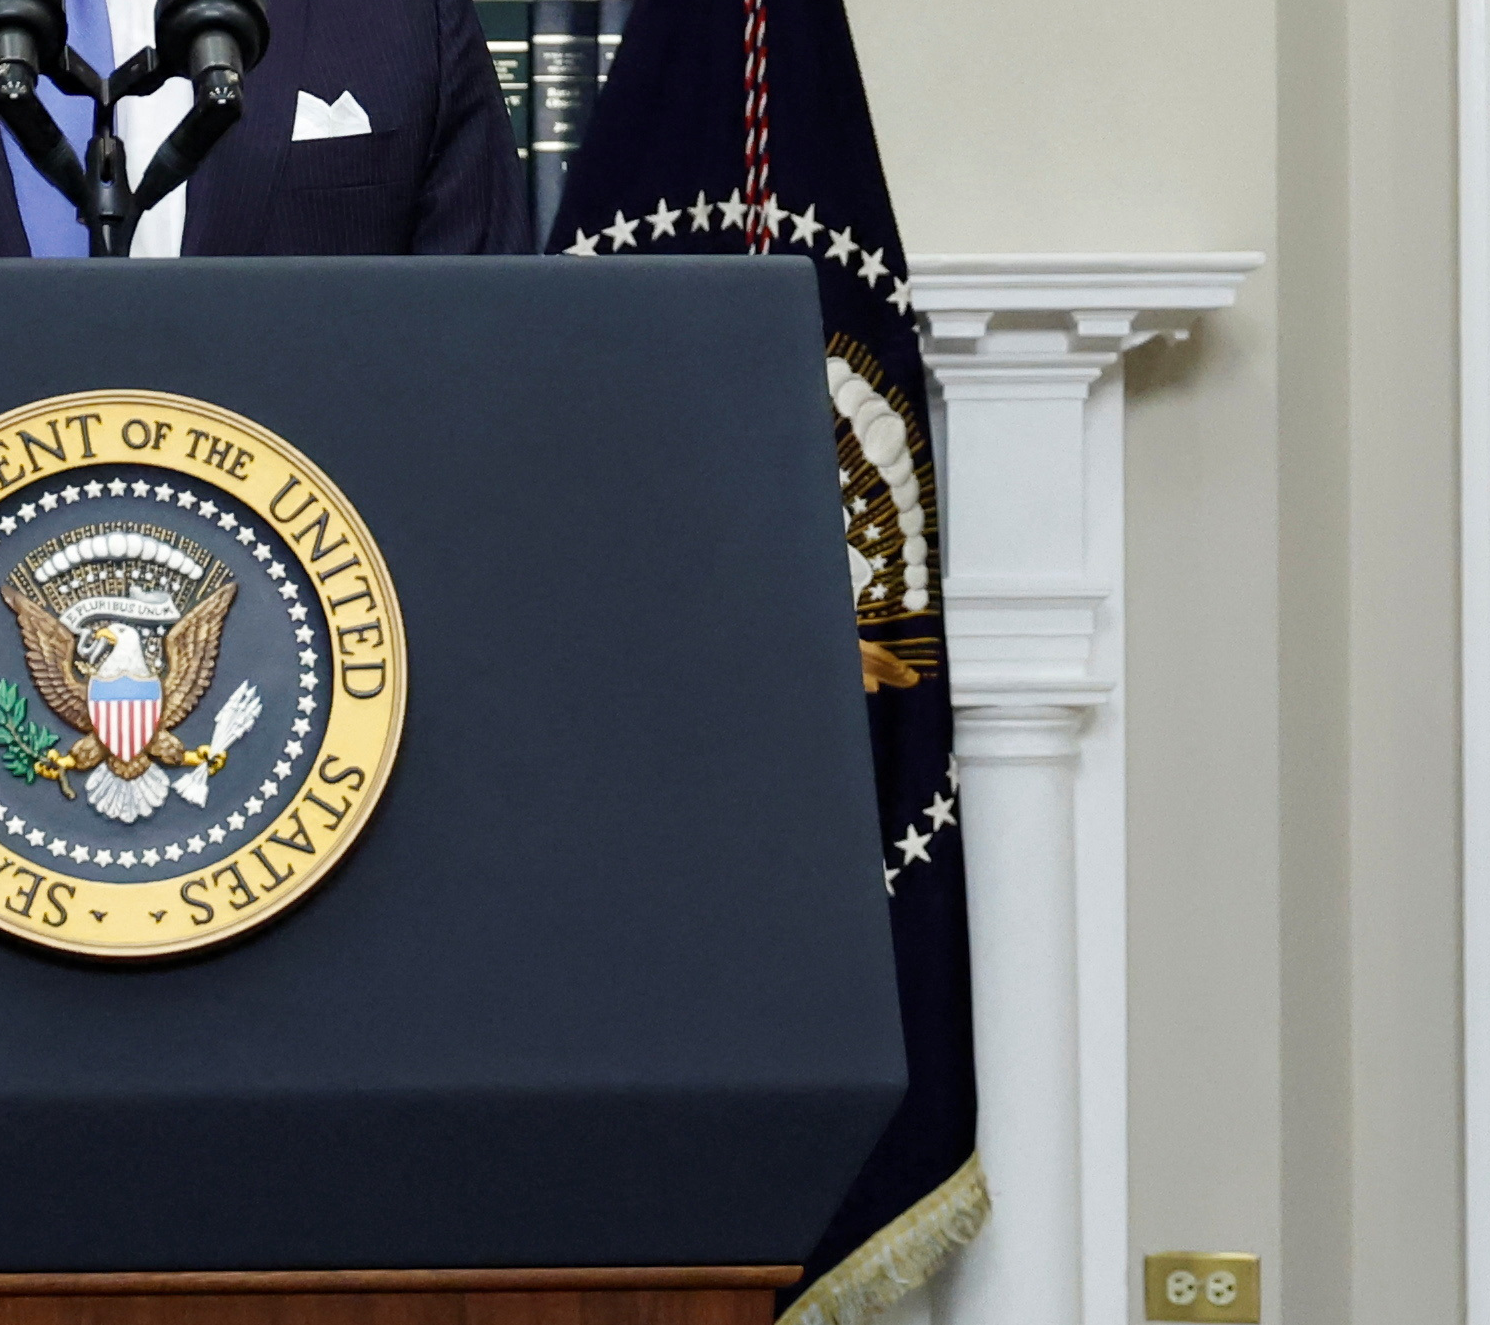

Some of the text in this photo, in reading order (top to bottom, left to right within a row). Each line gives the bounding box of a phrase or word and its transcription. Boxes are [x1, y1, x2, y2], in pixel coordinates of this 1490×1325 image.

[121, 418, 172, 451] OF
[185, 428, 255, 482] THE
[76, 600, 136, 616] PLURIBUS
[269, 473, 387, 700] UNITED
[179, 754, 366, 926] STATES
